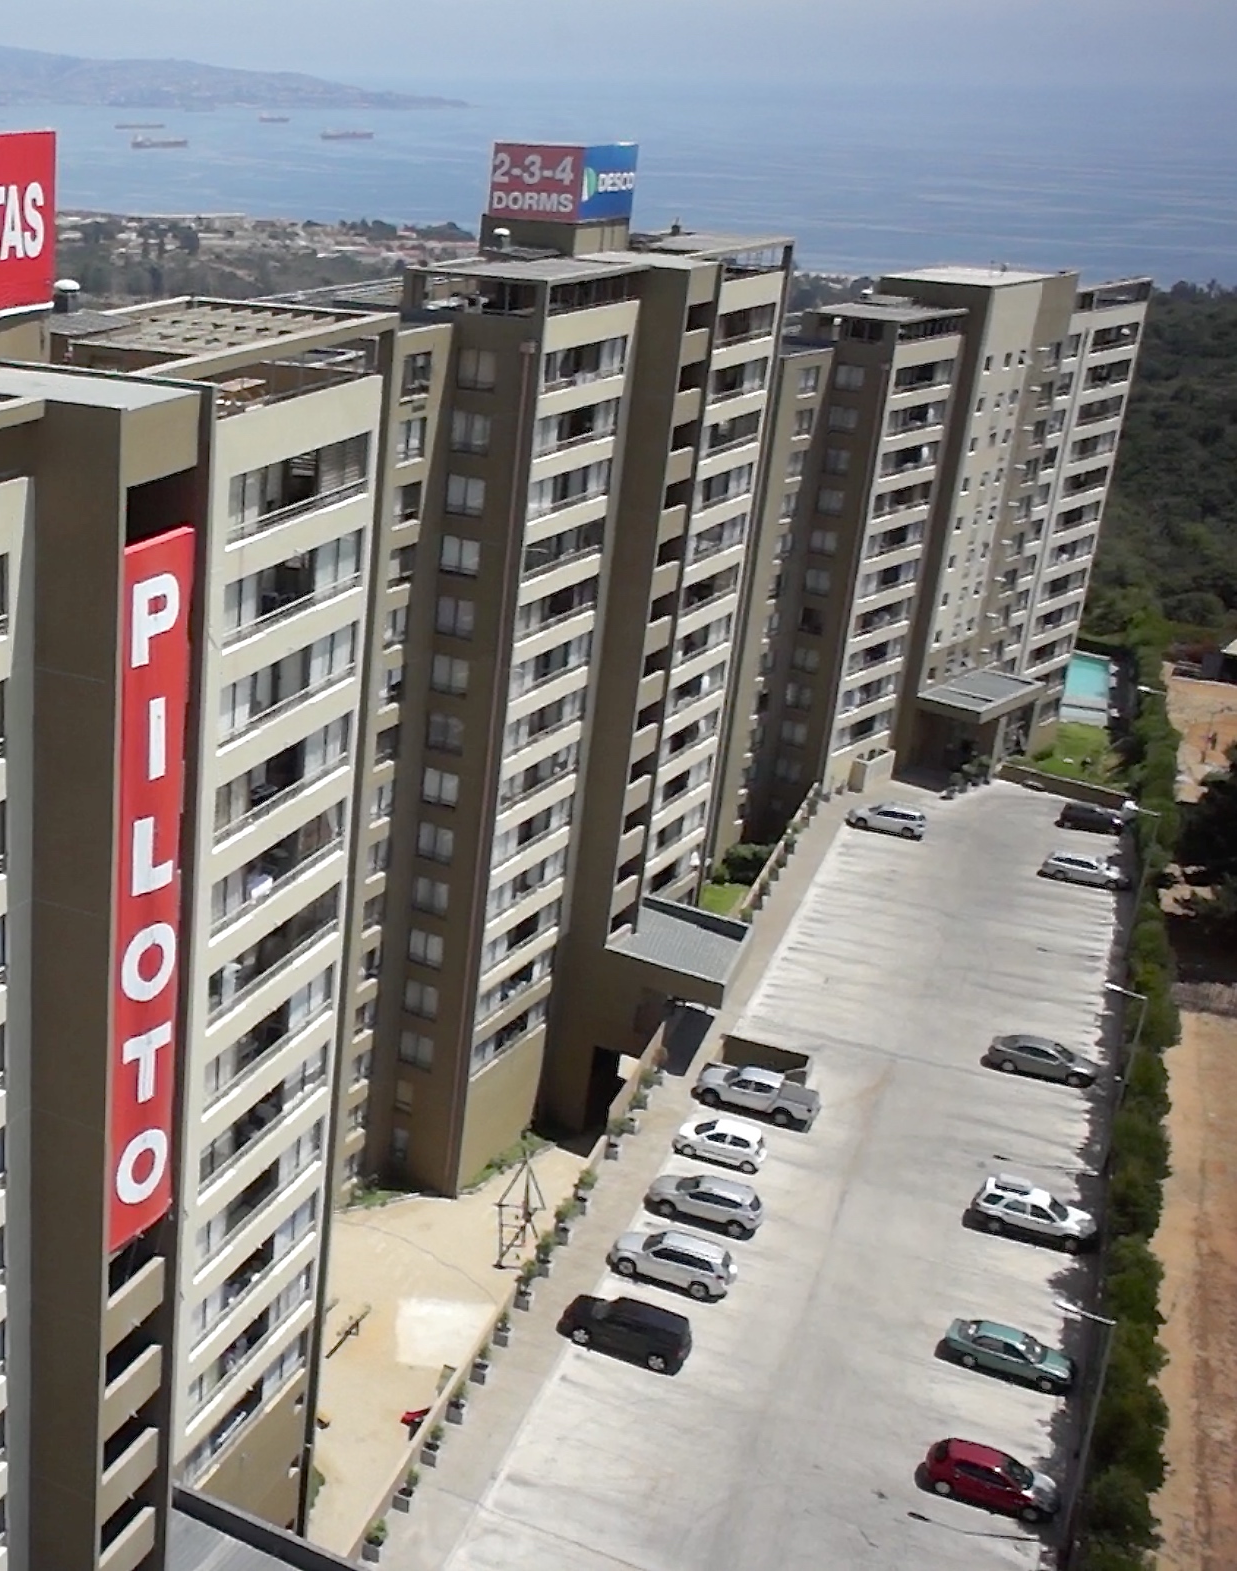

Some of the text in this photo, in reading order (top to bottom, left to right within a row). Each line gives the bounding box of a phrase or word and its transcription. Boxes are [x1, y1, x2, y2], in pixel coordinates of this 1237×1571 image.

[492, 153, 574, 186] 2-3-4
[597, 172, 635, 192] DESCO
[492, 191, 573, 213] DORMS
[117, 573, 179, 1204] PILOTO
